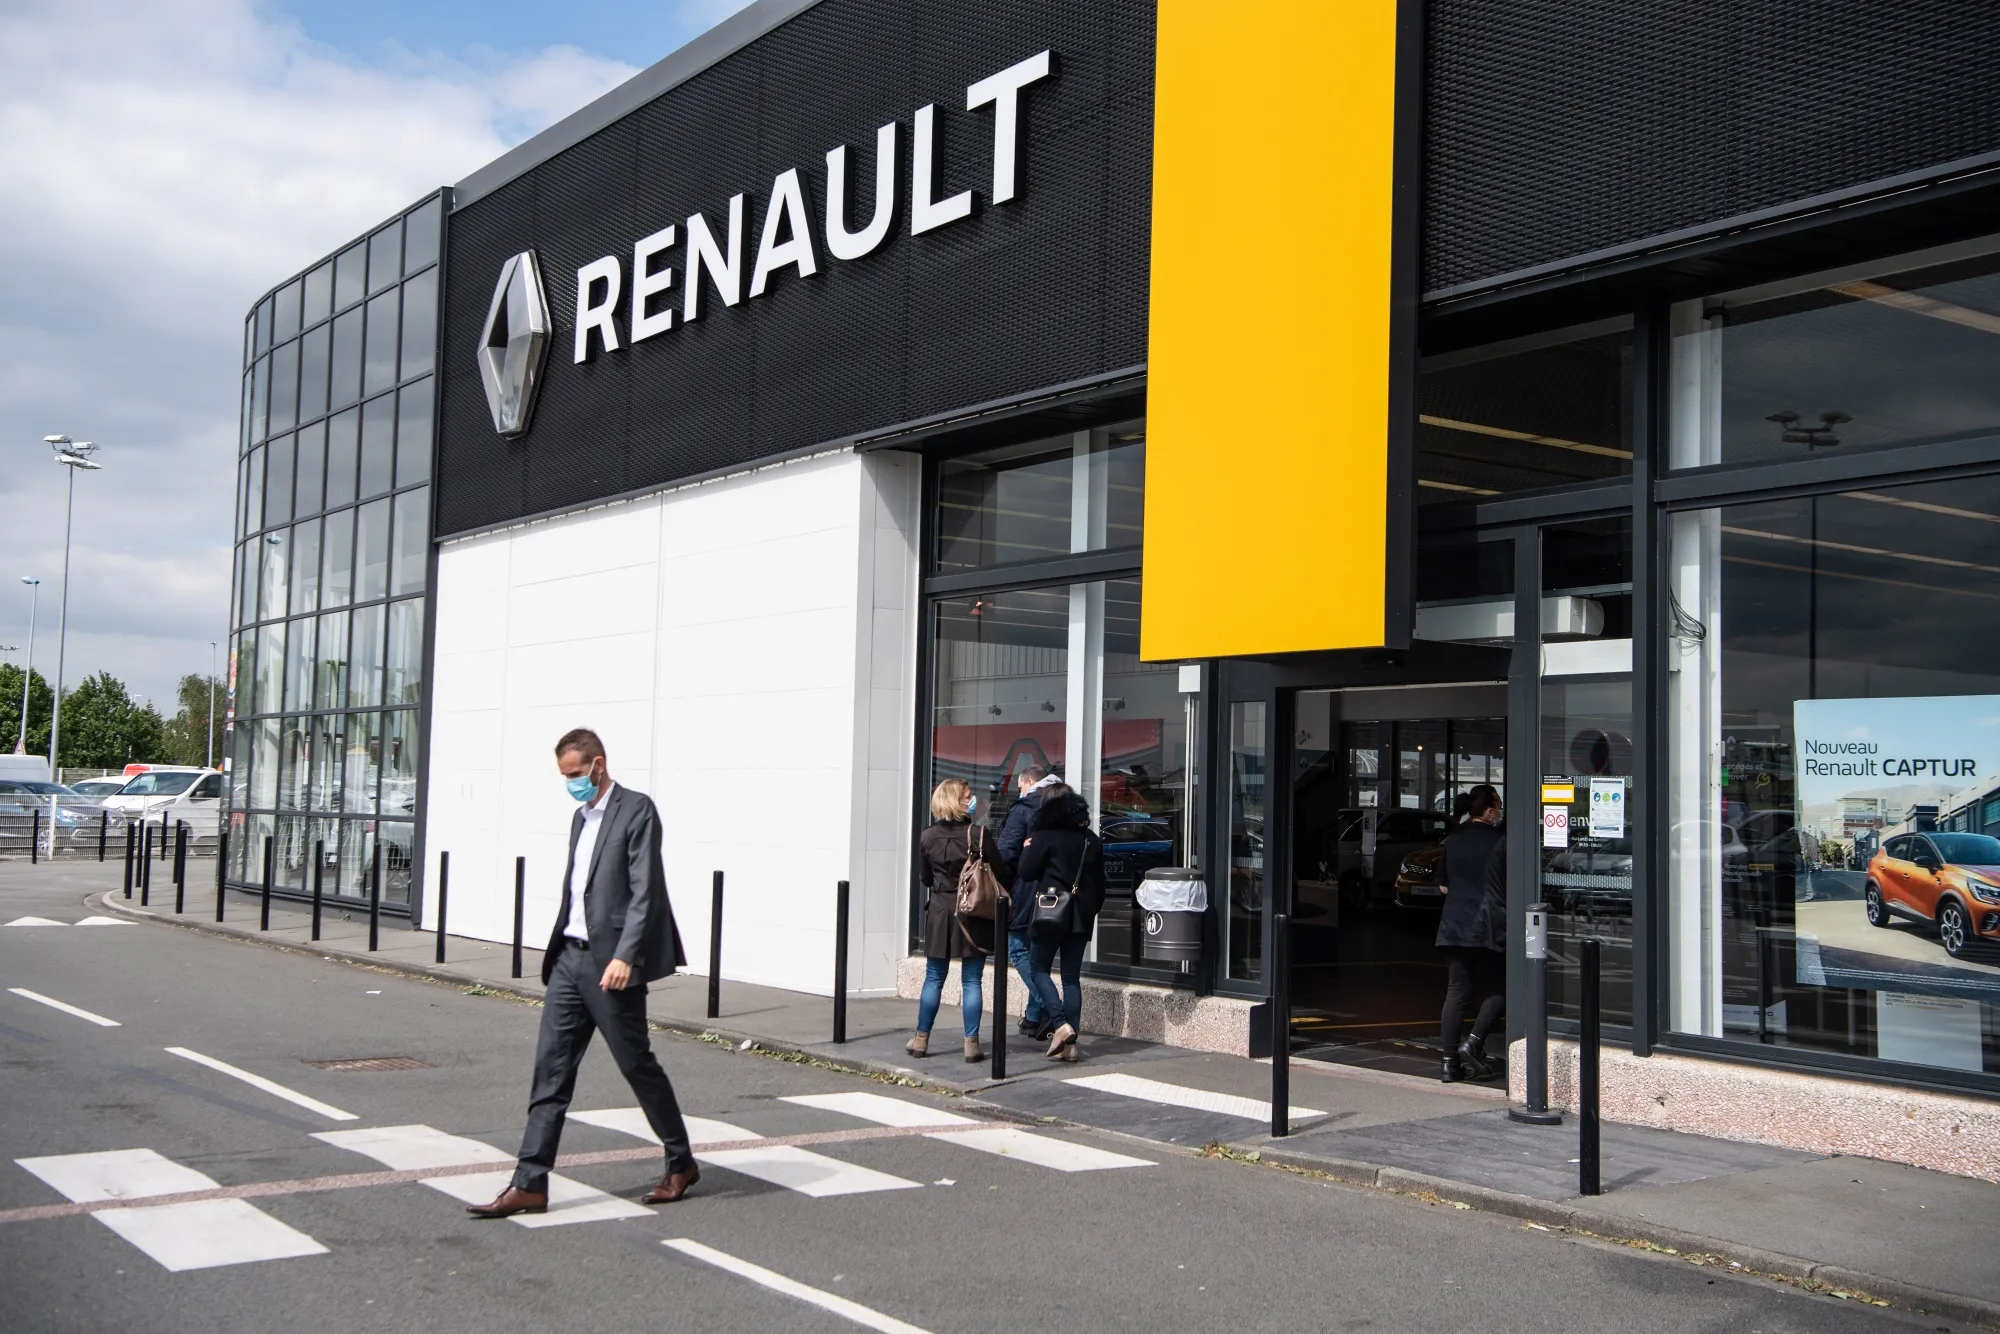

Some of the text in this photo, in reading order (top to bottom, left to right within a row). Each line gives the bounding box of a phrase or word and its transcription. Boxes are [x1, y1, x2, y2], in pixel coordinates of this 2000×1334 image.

[574, 49, 1054, 364] RENAULT
[1804, 739, 1878, 755] Nouveau
[1804, 758, 1977, 777] Renault CAPTUR
